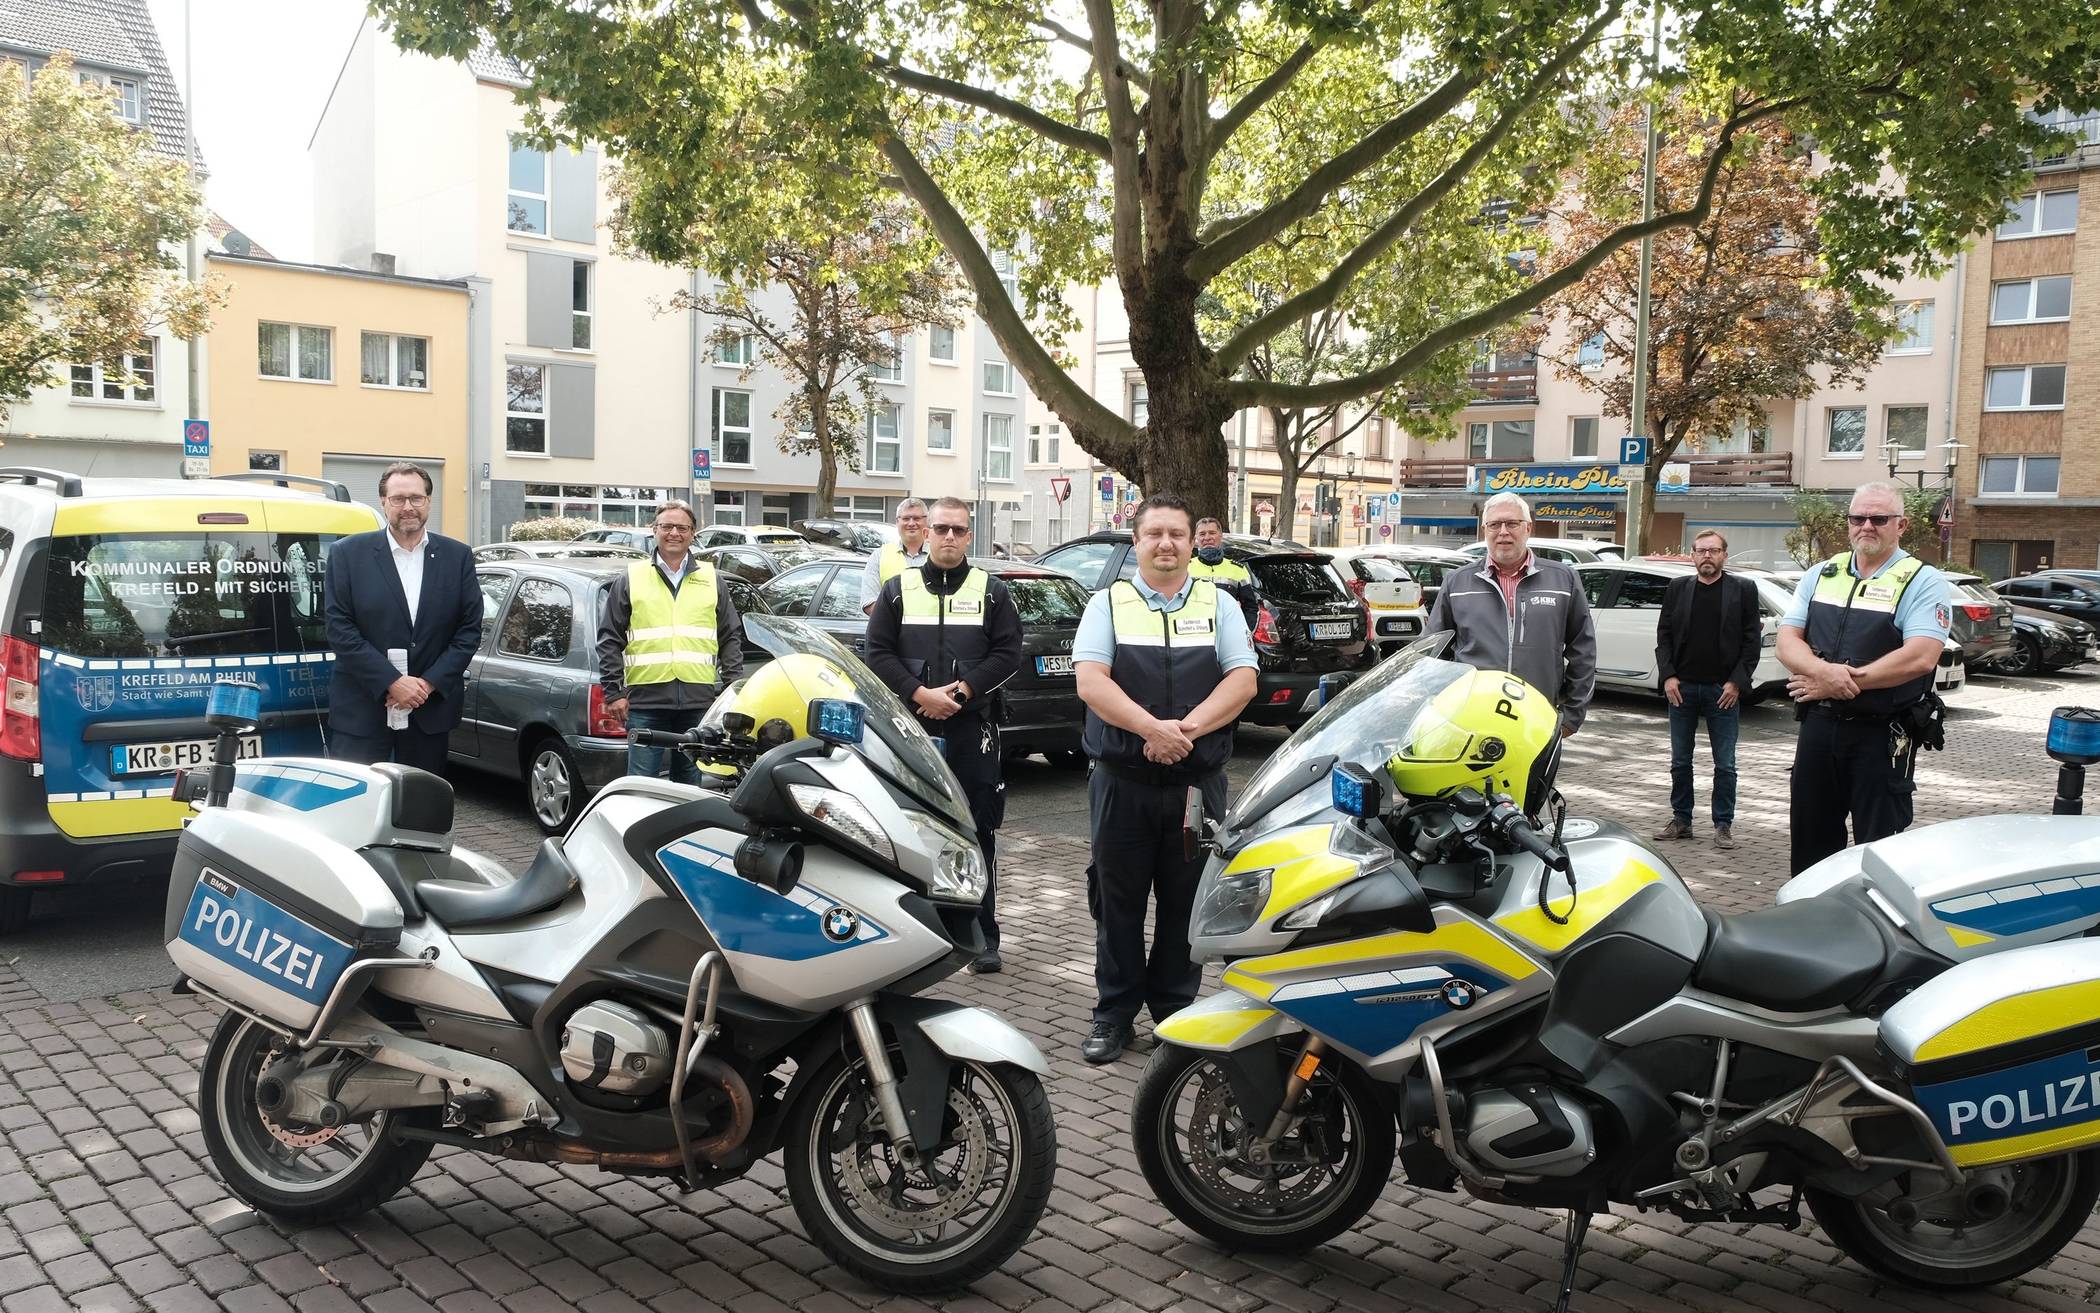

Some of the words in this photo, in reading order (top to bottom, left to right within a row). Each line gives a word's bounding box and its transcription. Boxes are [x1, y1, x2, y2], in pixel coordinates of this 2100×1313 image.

[187, 445, 208, 454] TAXI
[1625, 441, 1641, 462] P
[1490, 465, 1630, 490] RheinPla
[1536, 505, 1614, 519] RheinPlay
[111, 581, 199, 596] KREFELD
[215, 581, 244, 594] MIT
[1540, 596, 1556, 606] KBK
[1043, 657, 1061, 671] WES
[122, 673, 184, 687] KREFELD
[189, 673, 211, 684] AM
[122, 691, 151, 700] Stadt
[154, 690, 173, 699] wie
[177, 689, 204, 698] Samt
[128, 747, 157, 769] KR
[175, 743, 202, 765] FB
[208, 738, 260, 764] 311
[210, 877, 229, 893] BMW
[194, 895, 324, 990] POLIZEI
[1443, 981, 1473, 993] BMW
